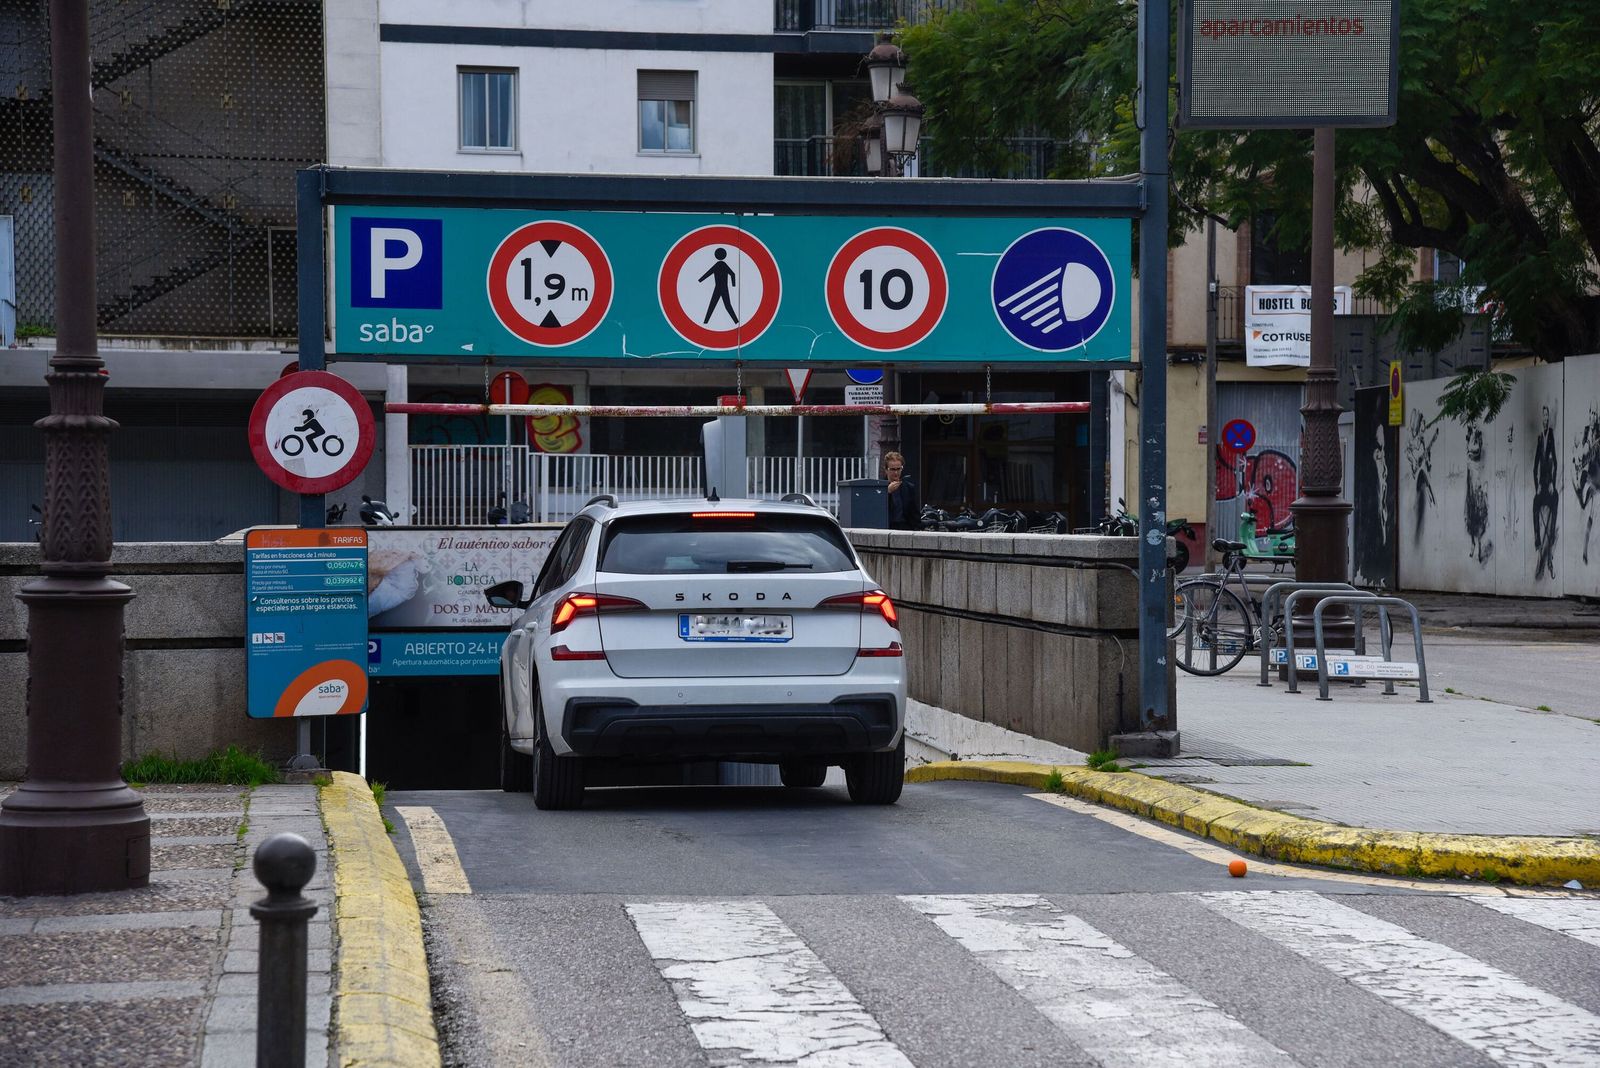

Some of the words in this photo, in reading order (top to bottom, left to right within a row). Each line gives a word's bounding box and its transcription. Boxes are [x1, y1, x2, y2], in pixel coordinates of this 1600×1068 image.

[1201, 15, 1364, 41] aparcamientos
[370, 227, 423, 298] P
[571, 287, 588, 301] m
[860, 268, 914, 311] 10
[1259, 297, 1294, 311] HOSTEL
[332, 536, 363, 544] TARIFAS
[437, 538, 451, 549] El
[455, 537, 508, 550] auténtico
[512, 538, 545, 549] sabor
[464, 561, 479, 571] LA
[447, 575, 496, 585] BODEGA
[331, 596, 354, 605] precios
[290, 604, 305, 612] para
[306, 604, 326, 612] largas
[433, 604, 459, 614] DOS
[404, 642, 465, 655] ABIERTO
[468, 642, 485, 655] 24
[488, 642, 498, 654] H
[392, 658, 422, 666] Apertura
[422, 657, 460, 665] automática
[460, 658, 473, 666] por
